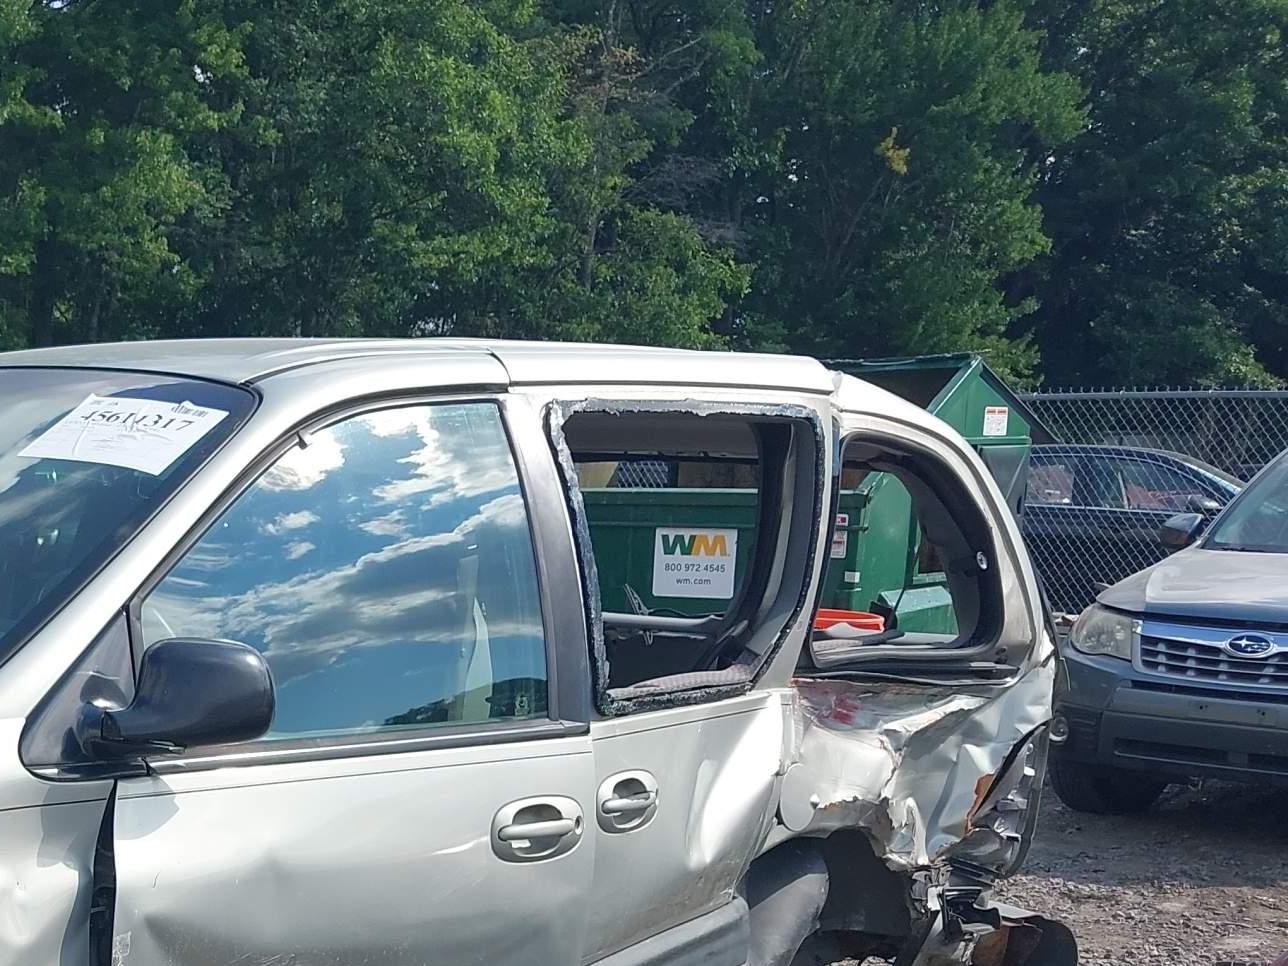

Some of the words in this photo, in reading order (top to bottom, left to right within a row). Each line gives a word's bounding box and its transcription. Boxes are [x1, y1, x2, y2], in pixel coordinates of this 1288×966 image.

[80, 410, 196, 431] 45611317
[661, 534, 728, 556] WM
[664, 563, 682, 572] 800
[684, 563, 701, 573] 972
[703, 564, 726, 573] 4545
[676, 577, 711, 585] wm.com
